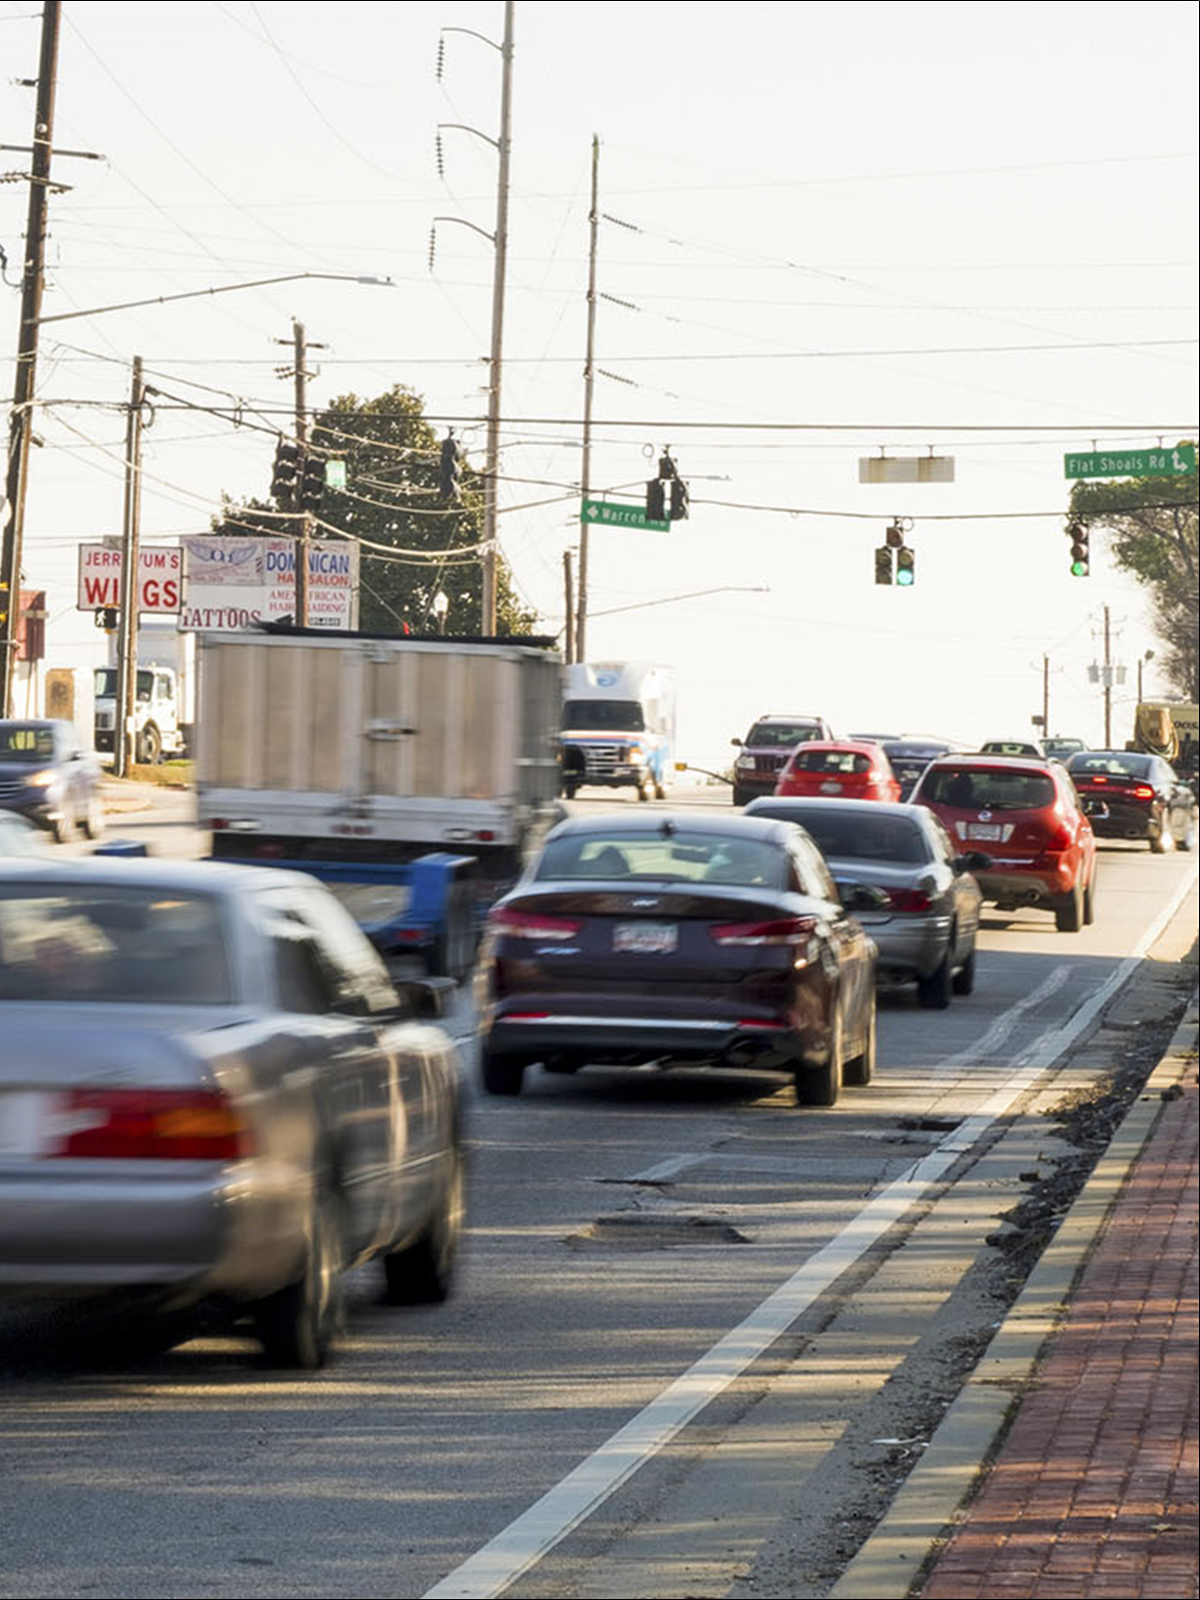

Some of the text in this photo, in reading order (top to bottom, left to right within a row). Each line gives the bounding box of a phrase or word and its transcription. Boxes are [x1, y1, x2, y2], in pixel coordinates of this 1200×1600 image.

[1069, 455, 1165, 473] Flat Shoals Rd
[602, 508, 646, 524] Warren
[85, 551, 179, 569] JERR UM'S
[277, 573, 349, 587] HA SALON
[84, 577, 178, 608] WIGS
[309, 591, 346, 602] FRICAN
[183, 608, 262, 629] TATTOOS
